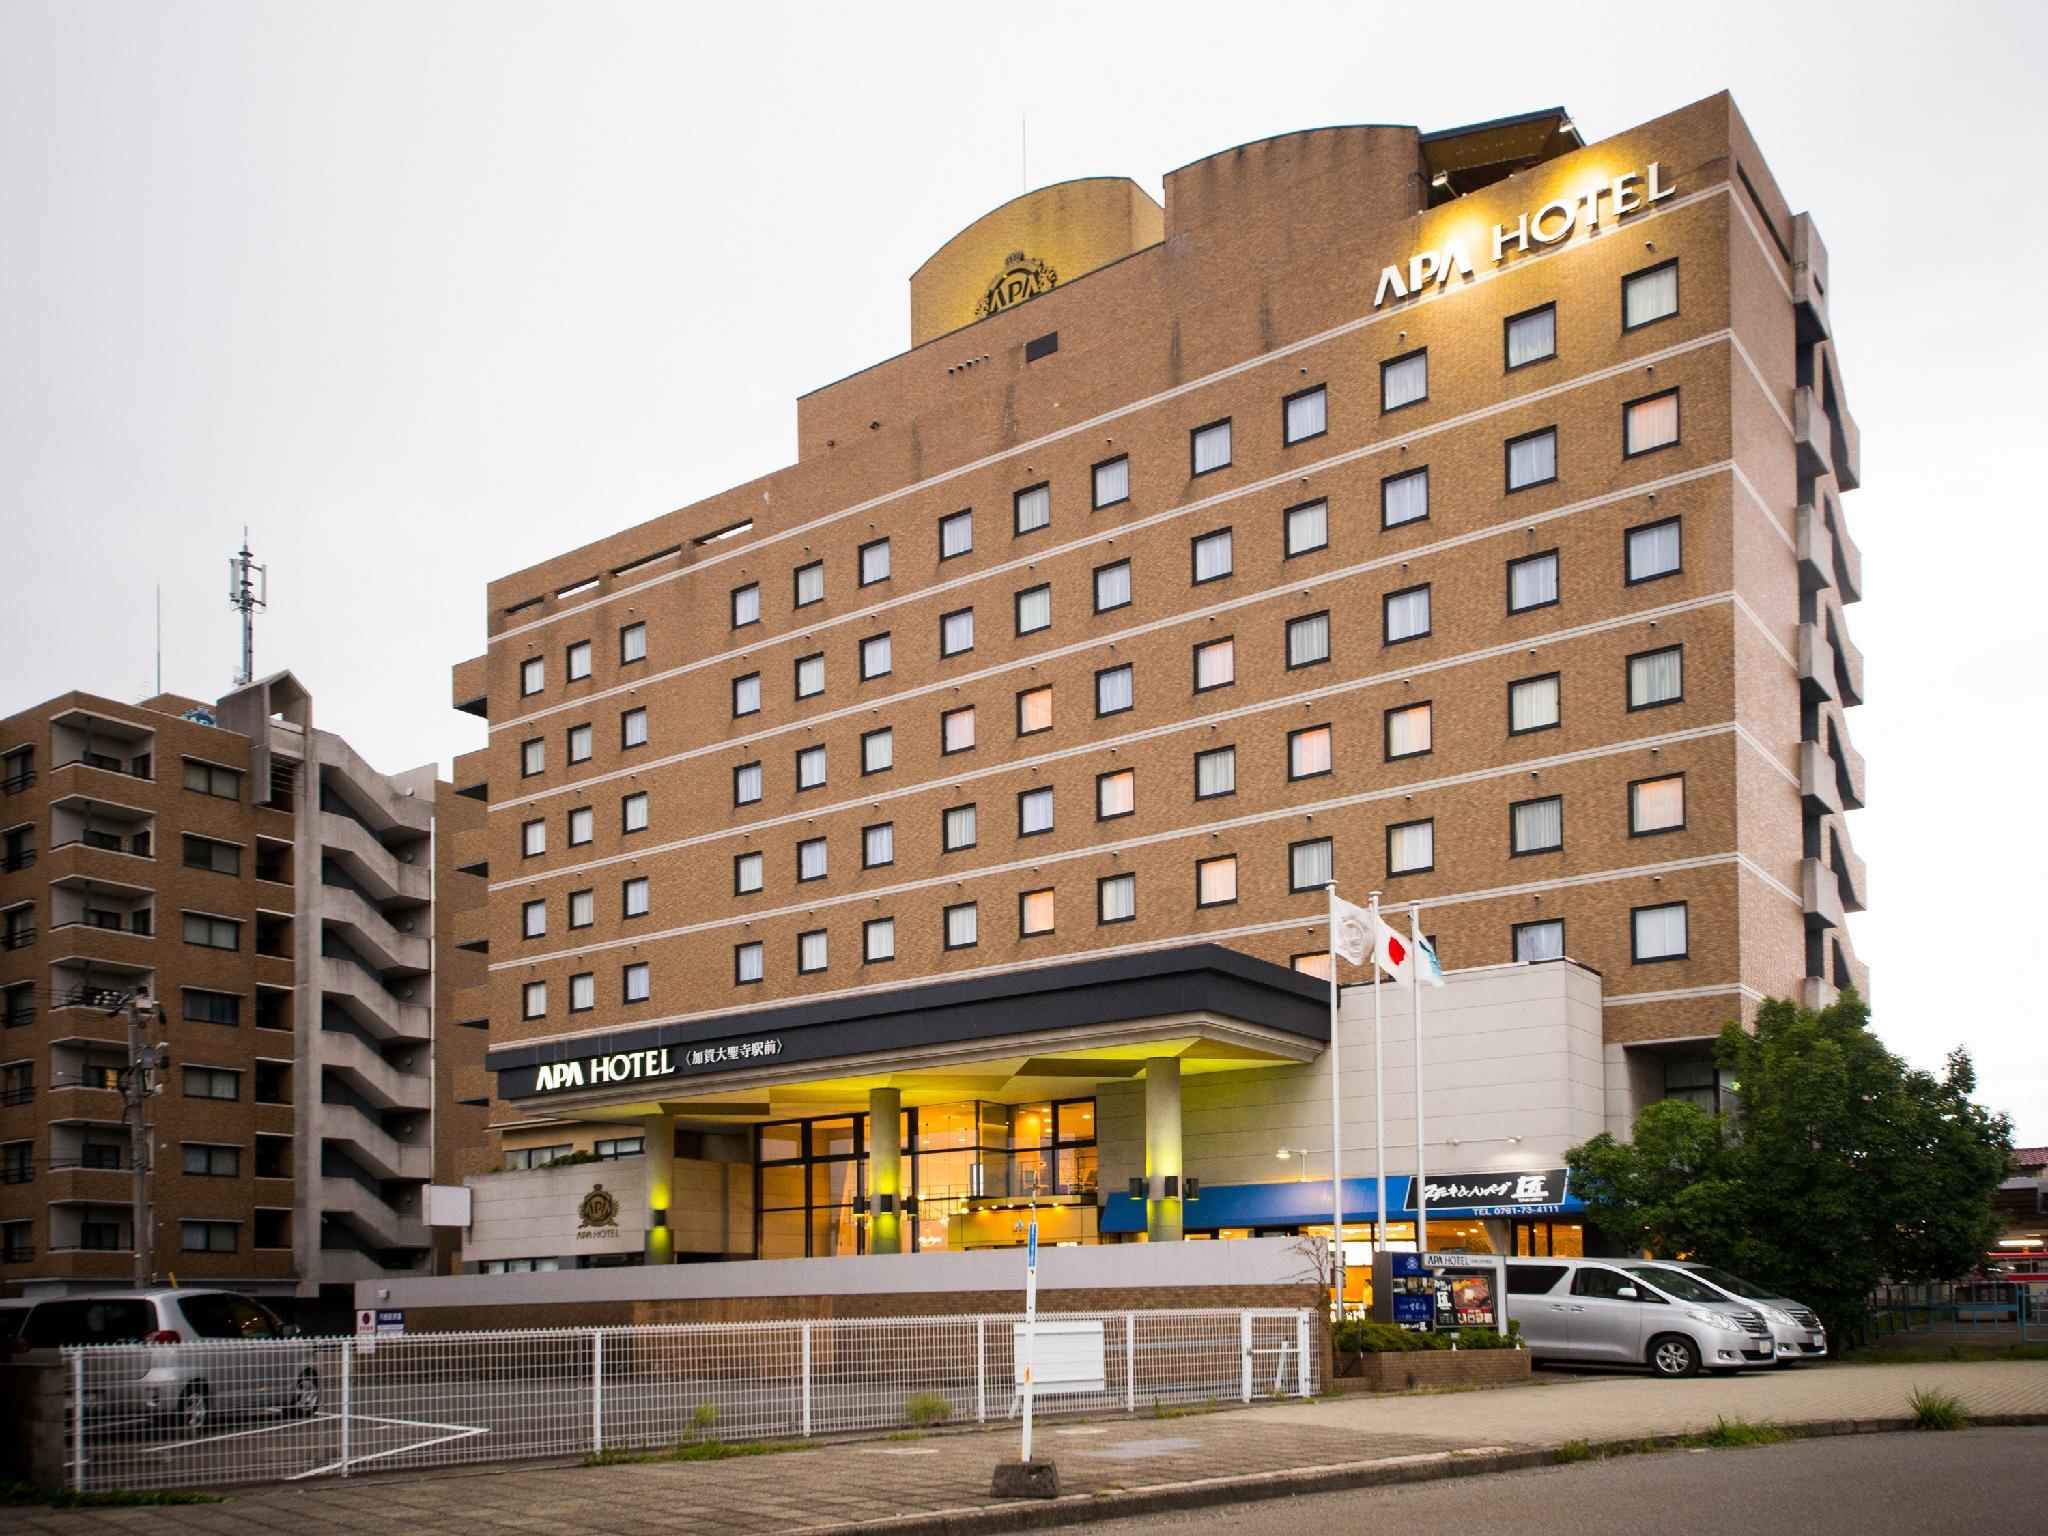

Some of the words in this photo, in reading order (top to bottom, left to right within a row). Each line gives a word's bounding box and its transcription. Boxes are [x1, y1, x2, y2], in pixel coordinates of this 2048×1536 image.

[1374, 240, 1473, 307] APA
[1491, 162, 1677, 263] HOTEL
[993, 276, 1036, 312] APA
[536, 1061, 585, 1091] APA
[591, 1049, 677, 1084] HOTEL
[1472, 1208, 1492, 1216] TEL
[1493, 1205, 1560, 1215] 0761-73-4111
[576, 1231, 592, 1240] APA
[593, 1229, 620, 1239] HOTEL
[1428, 1255, 1443, 1265] APA
[1444, 1255, 1470, 1266] HOTEL
